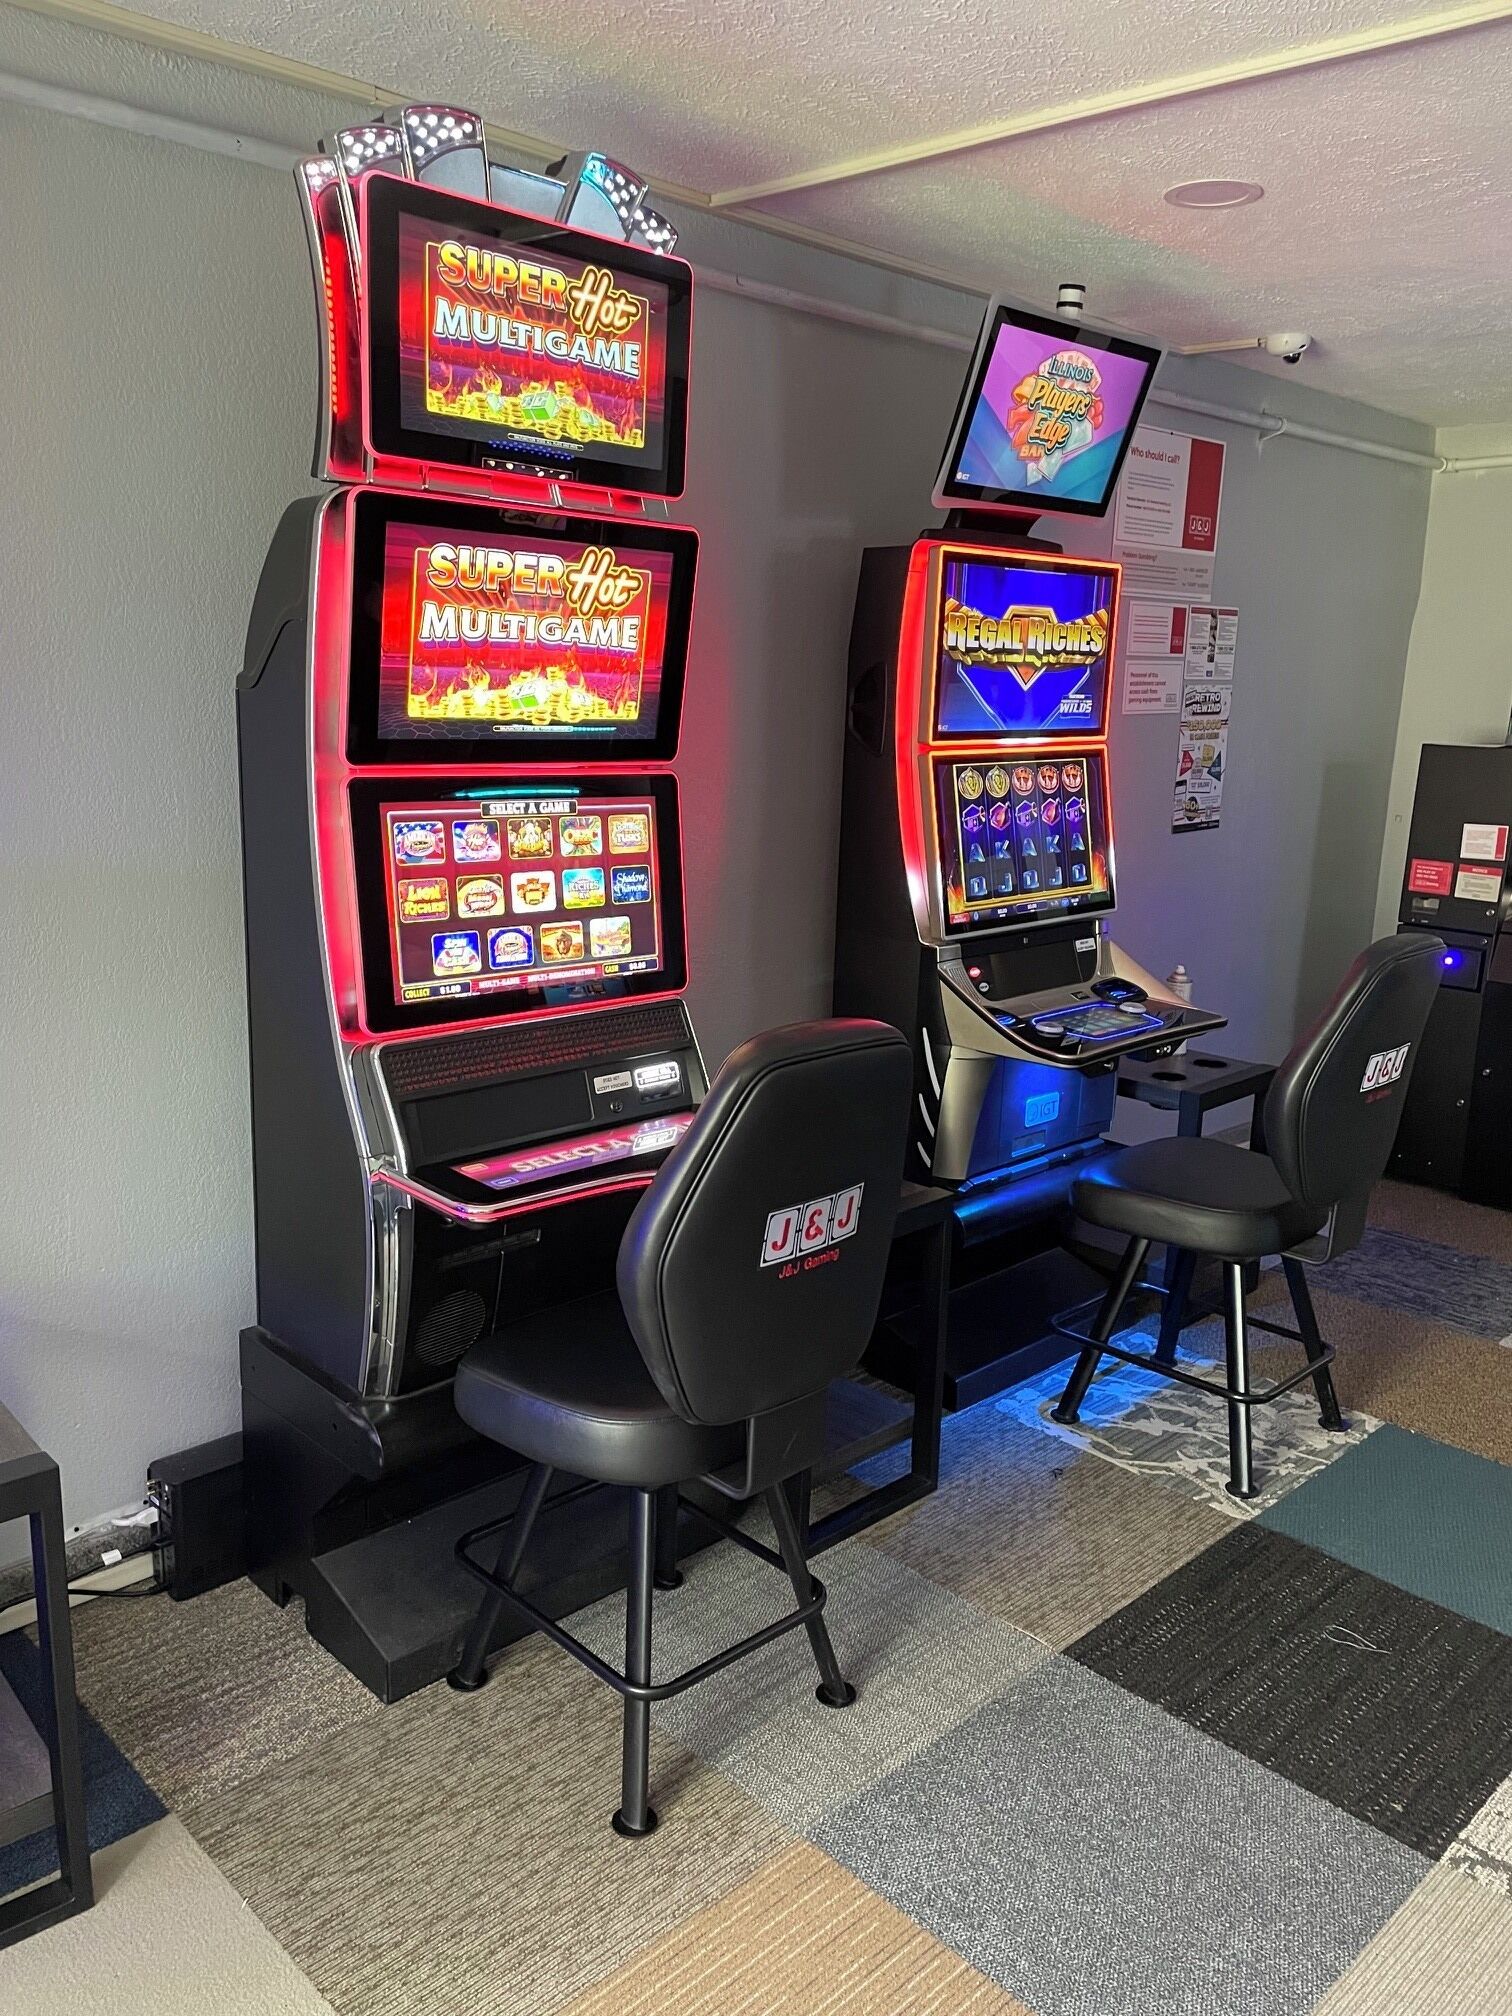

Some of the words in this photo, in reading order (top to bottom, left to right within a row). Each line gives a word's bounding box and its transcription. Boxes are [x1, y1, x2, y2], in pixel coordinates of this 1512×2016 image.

[437, 241, 568, 312] SUPER
[568, 267, 640, 336] Hot
[434, 297, 641, 377] MULTIGAME
[1047, 355, 1095, 382] ILLINOIS
[1028, 377, 1091, 419] Players
[1028, 413, 1072, 454] Edge
[1131, 446, 1144, 458] Who
[1145, 449, 1164, 461] should
[1168, 454, 1181, 464] call?
[427, 543, 565, 598] SUPER
[567, 547, 642, 617] Hot
[420, 601, 641, 652] MULTIGAME
[947, 611, 1024, 654] REGAL
[1027, 617, 1105, 655] RICHES
[1060, 702, 1092, 714] WILDS
[1192, 703, 1221, 713] REWIND
[1195, 692, 1221, 702] RETRO
[489, 803, 525, 815] SELECT
[528, 803, 537, 814] A
[540, 801, 570, 813] GAME
[617, 871, 646, 883] Shadow
[405, 988, 430, 998] COLLECT
[1041, 1100, 1058, 1116] IGT
[510, 1144, 606, 1173] SELECT
[771, 1194, 855, 1252] J&J
[779, 1261, 801, 1279] J&J
[804, 1248, 841, 1271] Gaming
